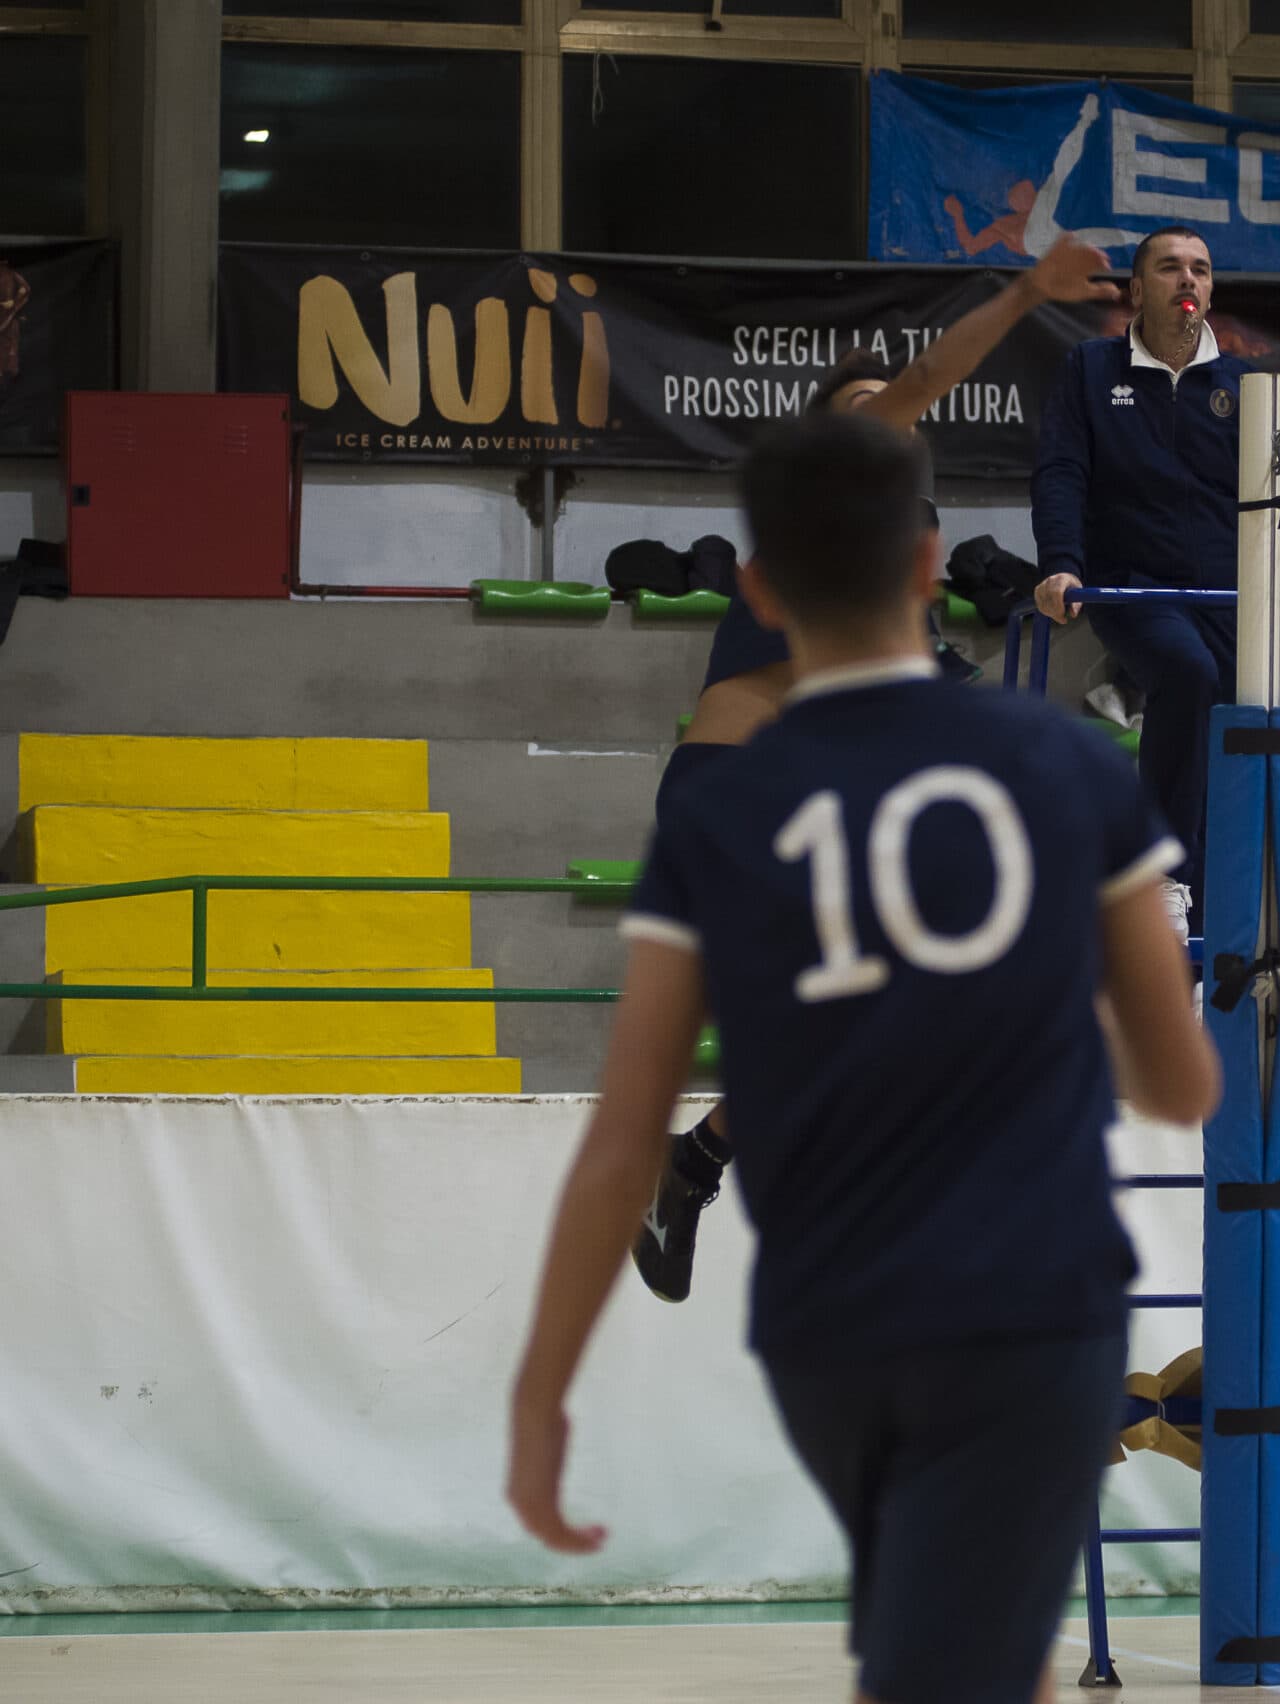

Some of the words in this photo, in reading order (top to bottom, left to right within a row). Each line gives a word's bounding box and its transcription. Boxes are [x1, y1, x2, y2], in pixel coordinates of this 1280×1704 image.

[733, 326, 836, 367] SCEGLI
[335, 433, 370, 448] ICE
[380, 434, 451, 449] CREAM
[462, 436, 580, 450] ADVENTURE
[774, 764, 1034, 1001] 10
